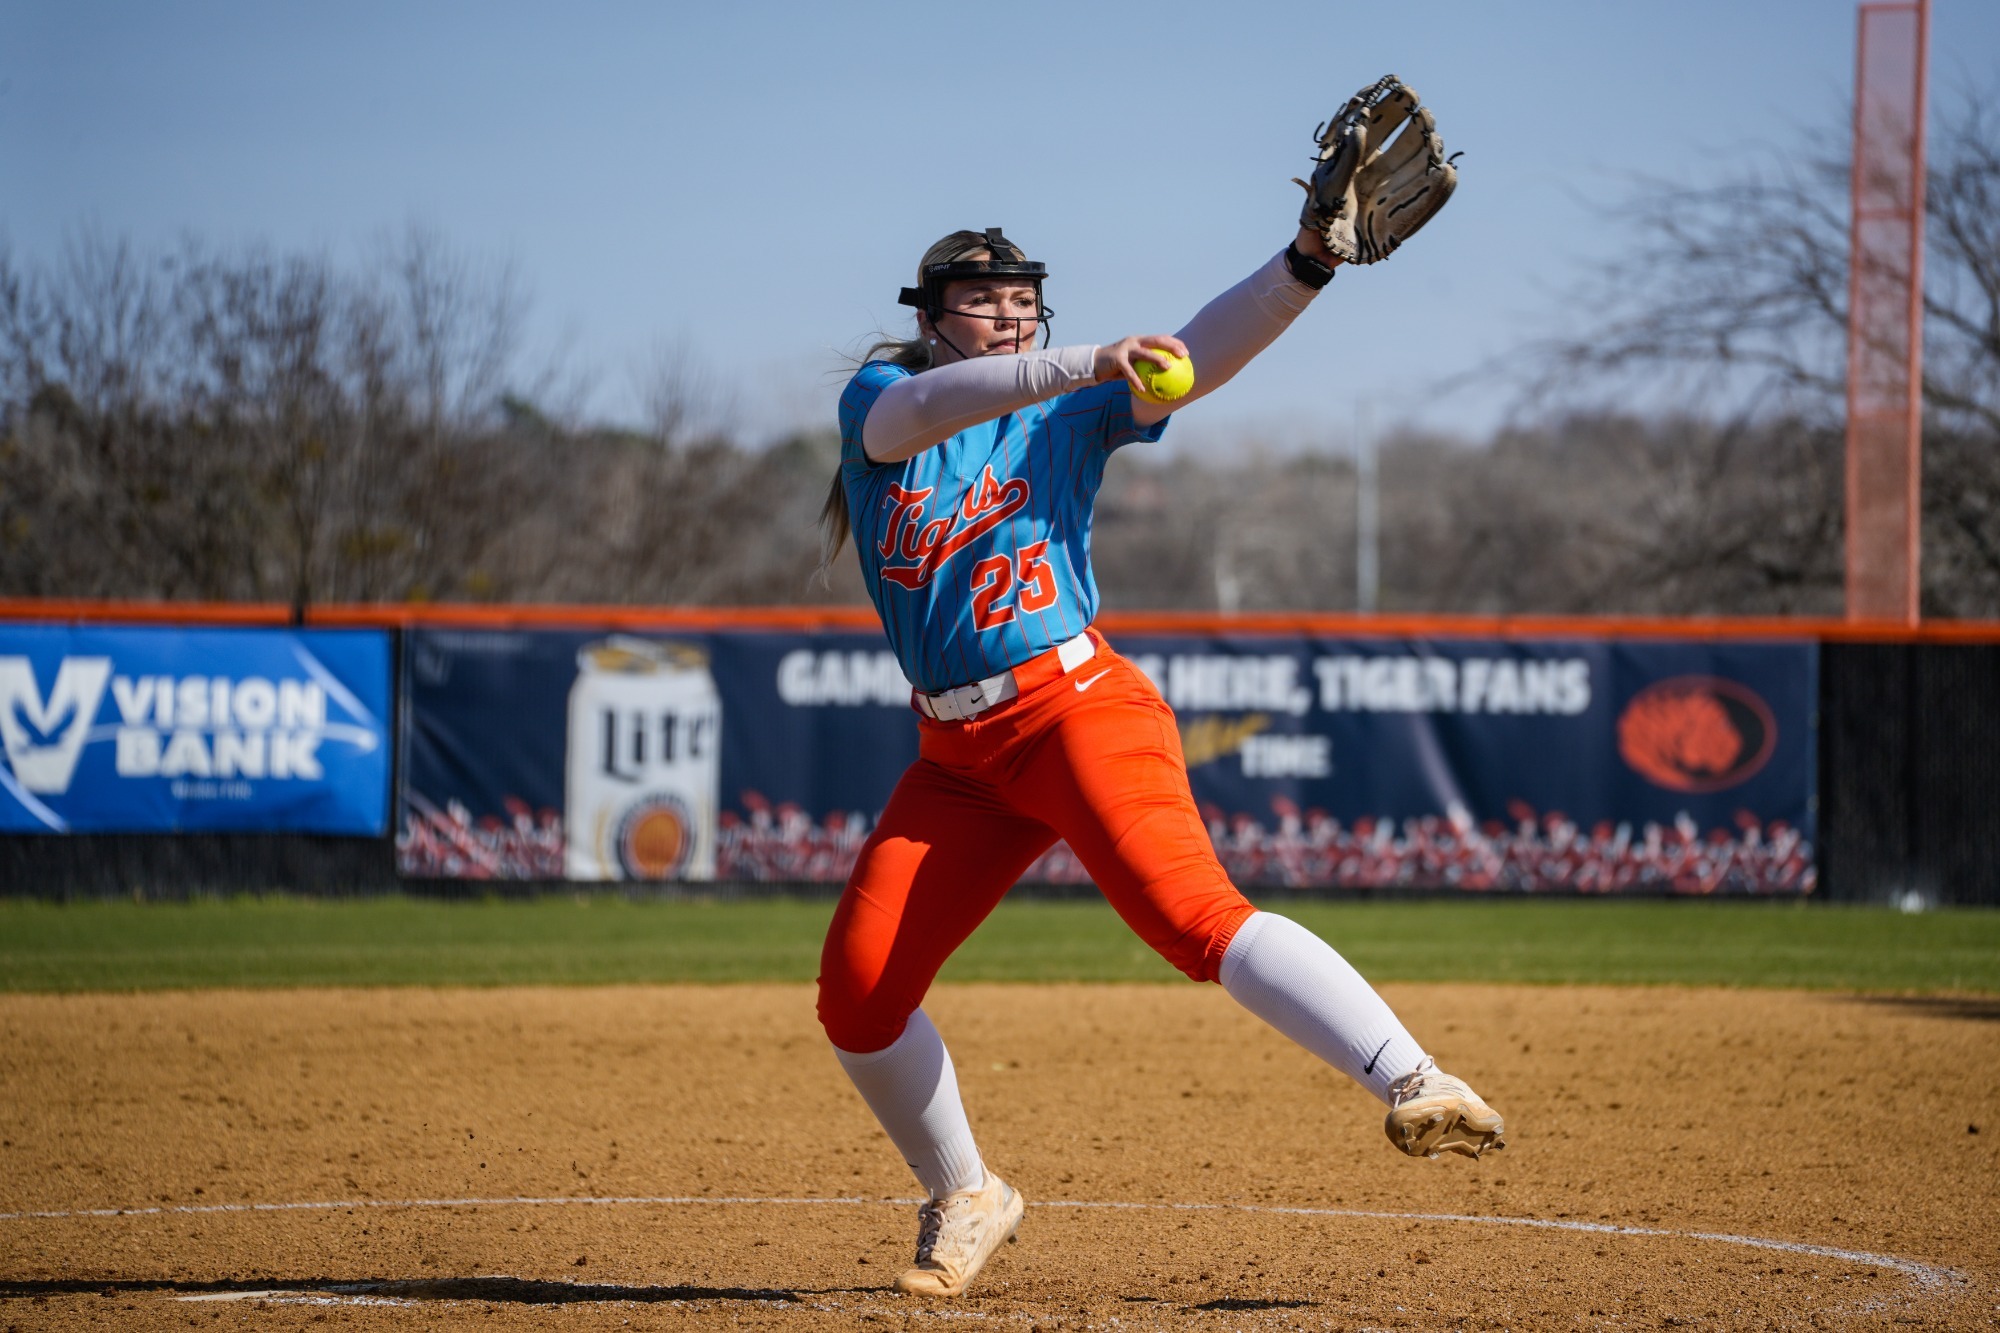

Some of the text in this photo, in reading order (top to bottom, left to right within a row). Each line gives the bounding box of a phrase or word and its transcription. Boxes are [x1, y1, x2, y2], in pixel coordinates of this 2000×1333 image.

[878, 464, 1029, 590] Tigs
[970, 539, 1059, 633] 25
[111, 675, 326, 728] VISION
[1460, 658, 1591, 714] FANS
[115, 728, 324, 780] BANK
